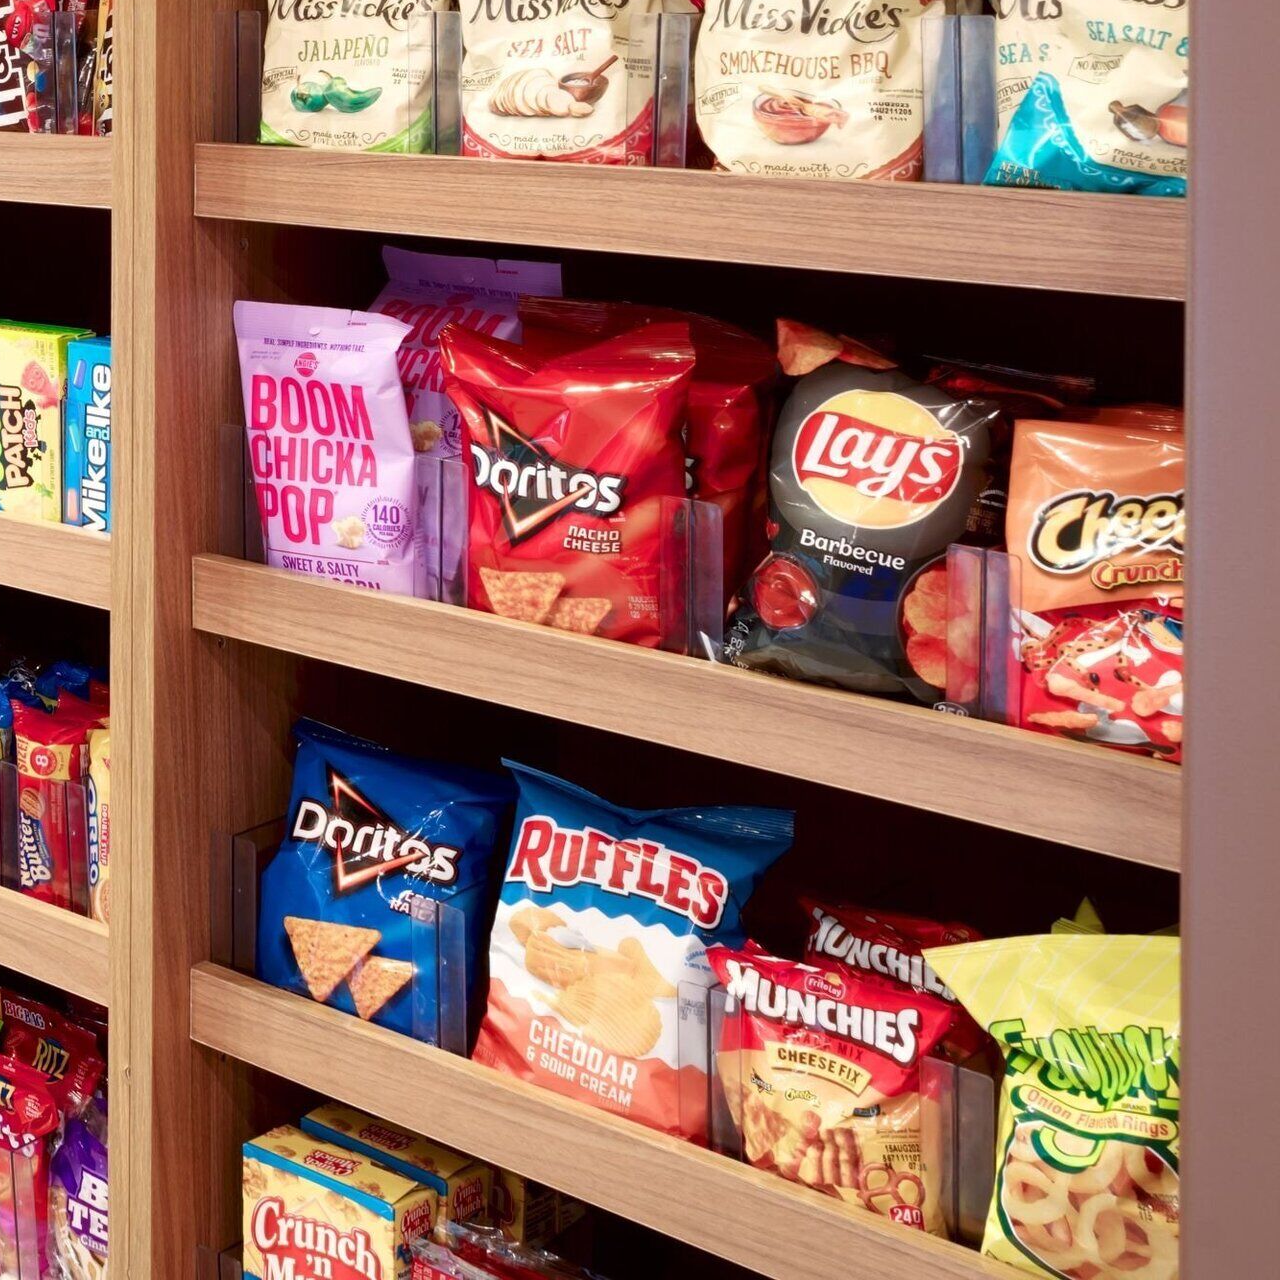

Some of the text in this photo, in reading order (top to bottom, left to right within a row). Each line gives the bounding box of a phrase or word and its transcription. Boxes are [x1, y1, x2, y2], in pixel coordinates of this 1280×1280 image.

[297, 34, 389, 63] JALAPEÑO
[507, 28, 592, 58] SEA SALT
[1086, 20, 1119, 44] SEA
[720, 51, 892, 79] SMOKEHOUSE BBQ
[999, 43, 1033, 65] SEA
[1112, 155, 1145, 169] LOVE
[1114, 147, 1151, 163] made
[293, 357, 320, 370] ANGIE'S
[87, 364, 111, 426] Ike
[251, 373, 375, 441] BOOM
[0, 384, 33, 489] PATCH
[22, 408, 39, 449] Kids
[86, 426, 110, 442] and
[251, 433, 378, 488] CHICKA
[801, 413, 956, 498] Lay's
[470, 442, 623, 512] Doritos
[257, 482, 335, 546] POP
[371, 504, 400, 525] 140
[568, 524, 620, 541] NACHO
[562, 537, 621, 554] CHEESE
[800, 529, 906, 571] Barbecue
[282, 555, 360, 579] SWEET & SALTY
[823, 554, 874, 577] Flavored
[37, 753, 49, 767] 8
[292, 800, 458, 884] Doritos
[508, 818, 729, 930] RUFFLES
[5, 999, 25, 1021] BIG
[724, 958, 920, 1065] MUNCHIES
[35, 1037, 70, 1081] RITZ
[528, 1018, 639, 1090] CHEDDAR
[777, 1047, 860, 1084] CHEESE FIX
[526, 1045, 633, 1108] & SOUR CREAM
[1027, 1088, 1071, 1120] Onion
[1121, 1114, 1170, 1138] Rings
[893, 1207, 921, 1224] 240
[254, 1198, 377, 1280] Crunch
